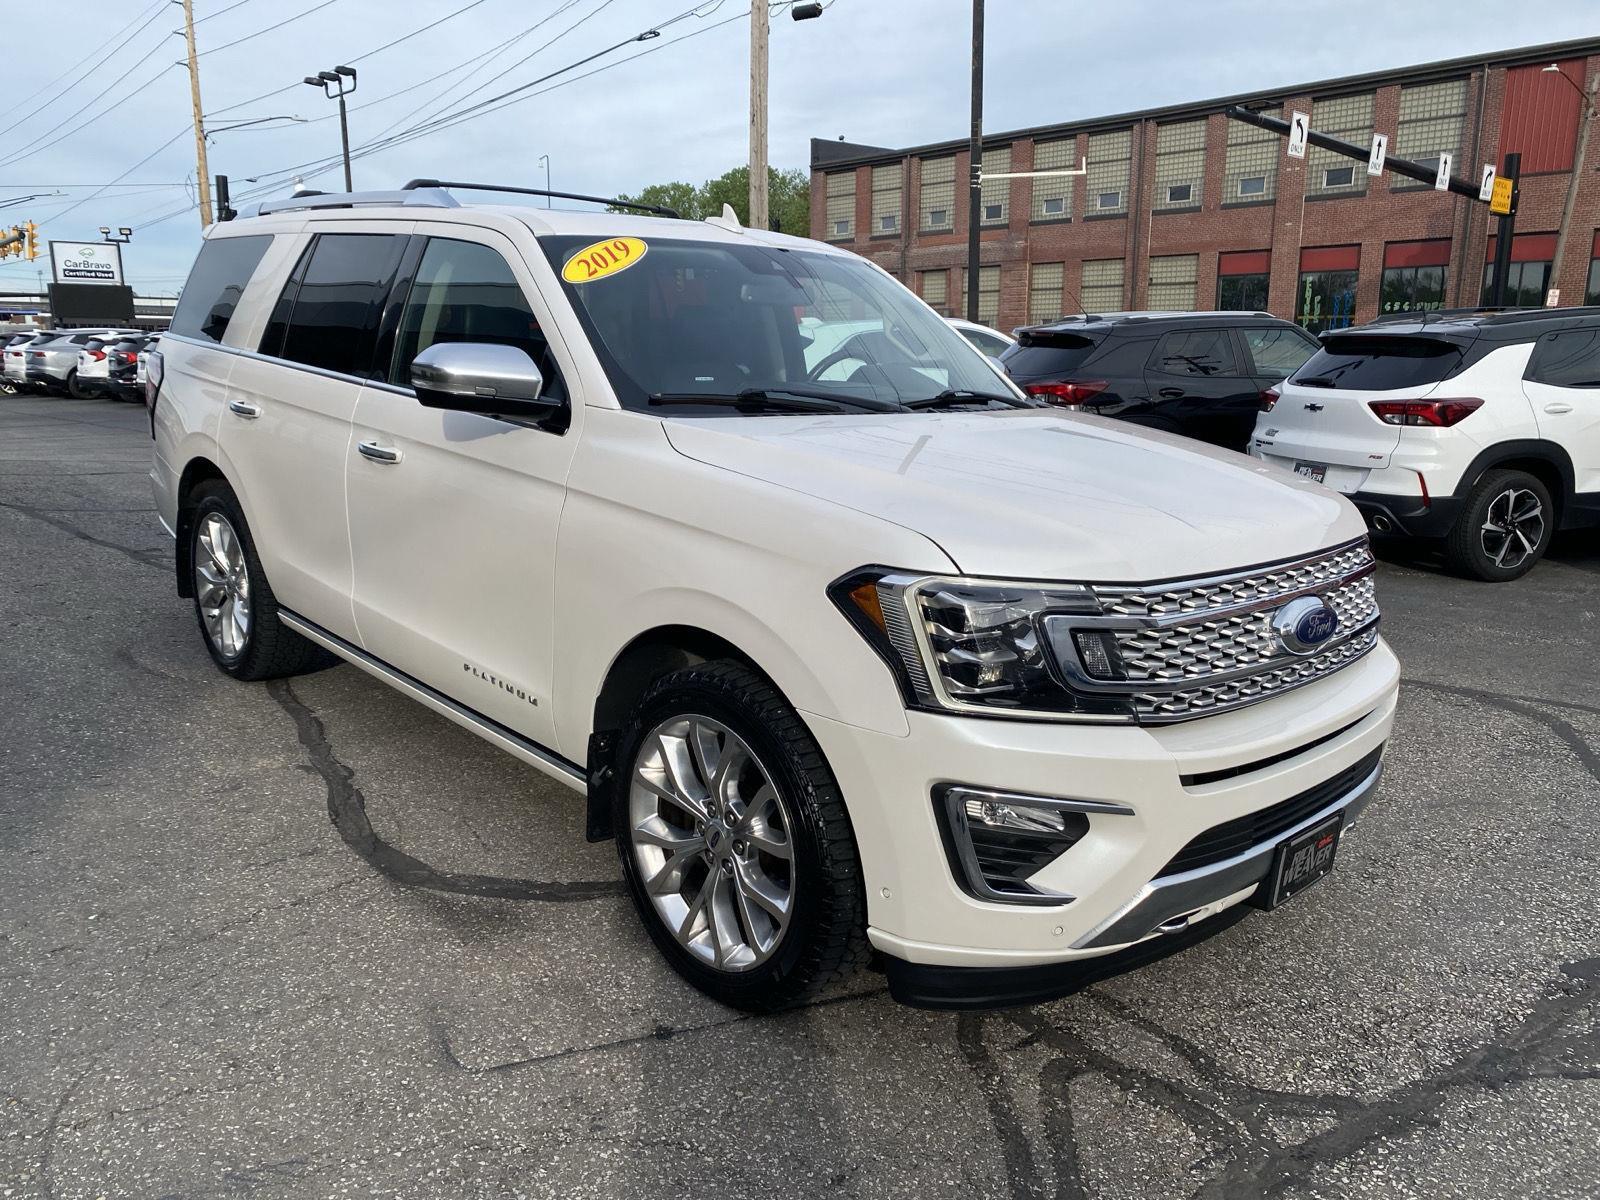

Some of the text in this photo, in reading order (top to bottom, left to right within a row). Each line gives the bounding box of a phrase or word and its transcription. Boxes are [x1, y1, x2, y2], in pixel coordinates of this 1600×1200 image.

[1290, 143, 1304, 154] ONLY
[1370, 161, 1382, 171] ONLY
[64, 259, 112, 269] CarBravo
[577, 240, 630, 277] 2019
[1308, 612, 1332, 639] Ford
[463, 663, 538, 707] PLATINUM
[1282, 843, 1334, 887] WEAVER
